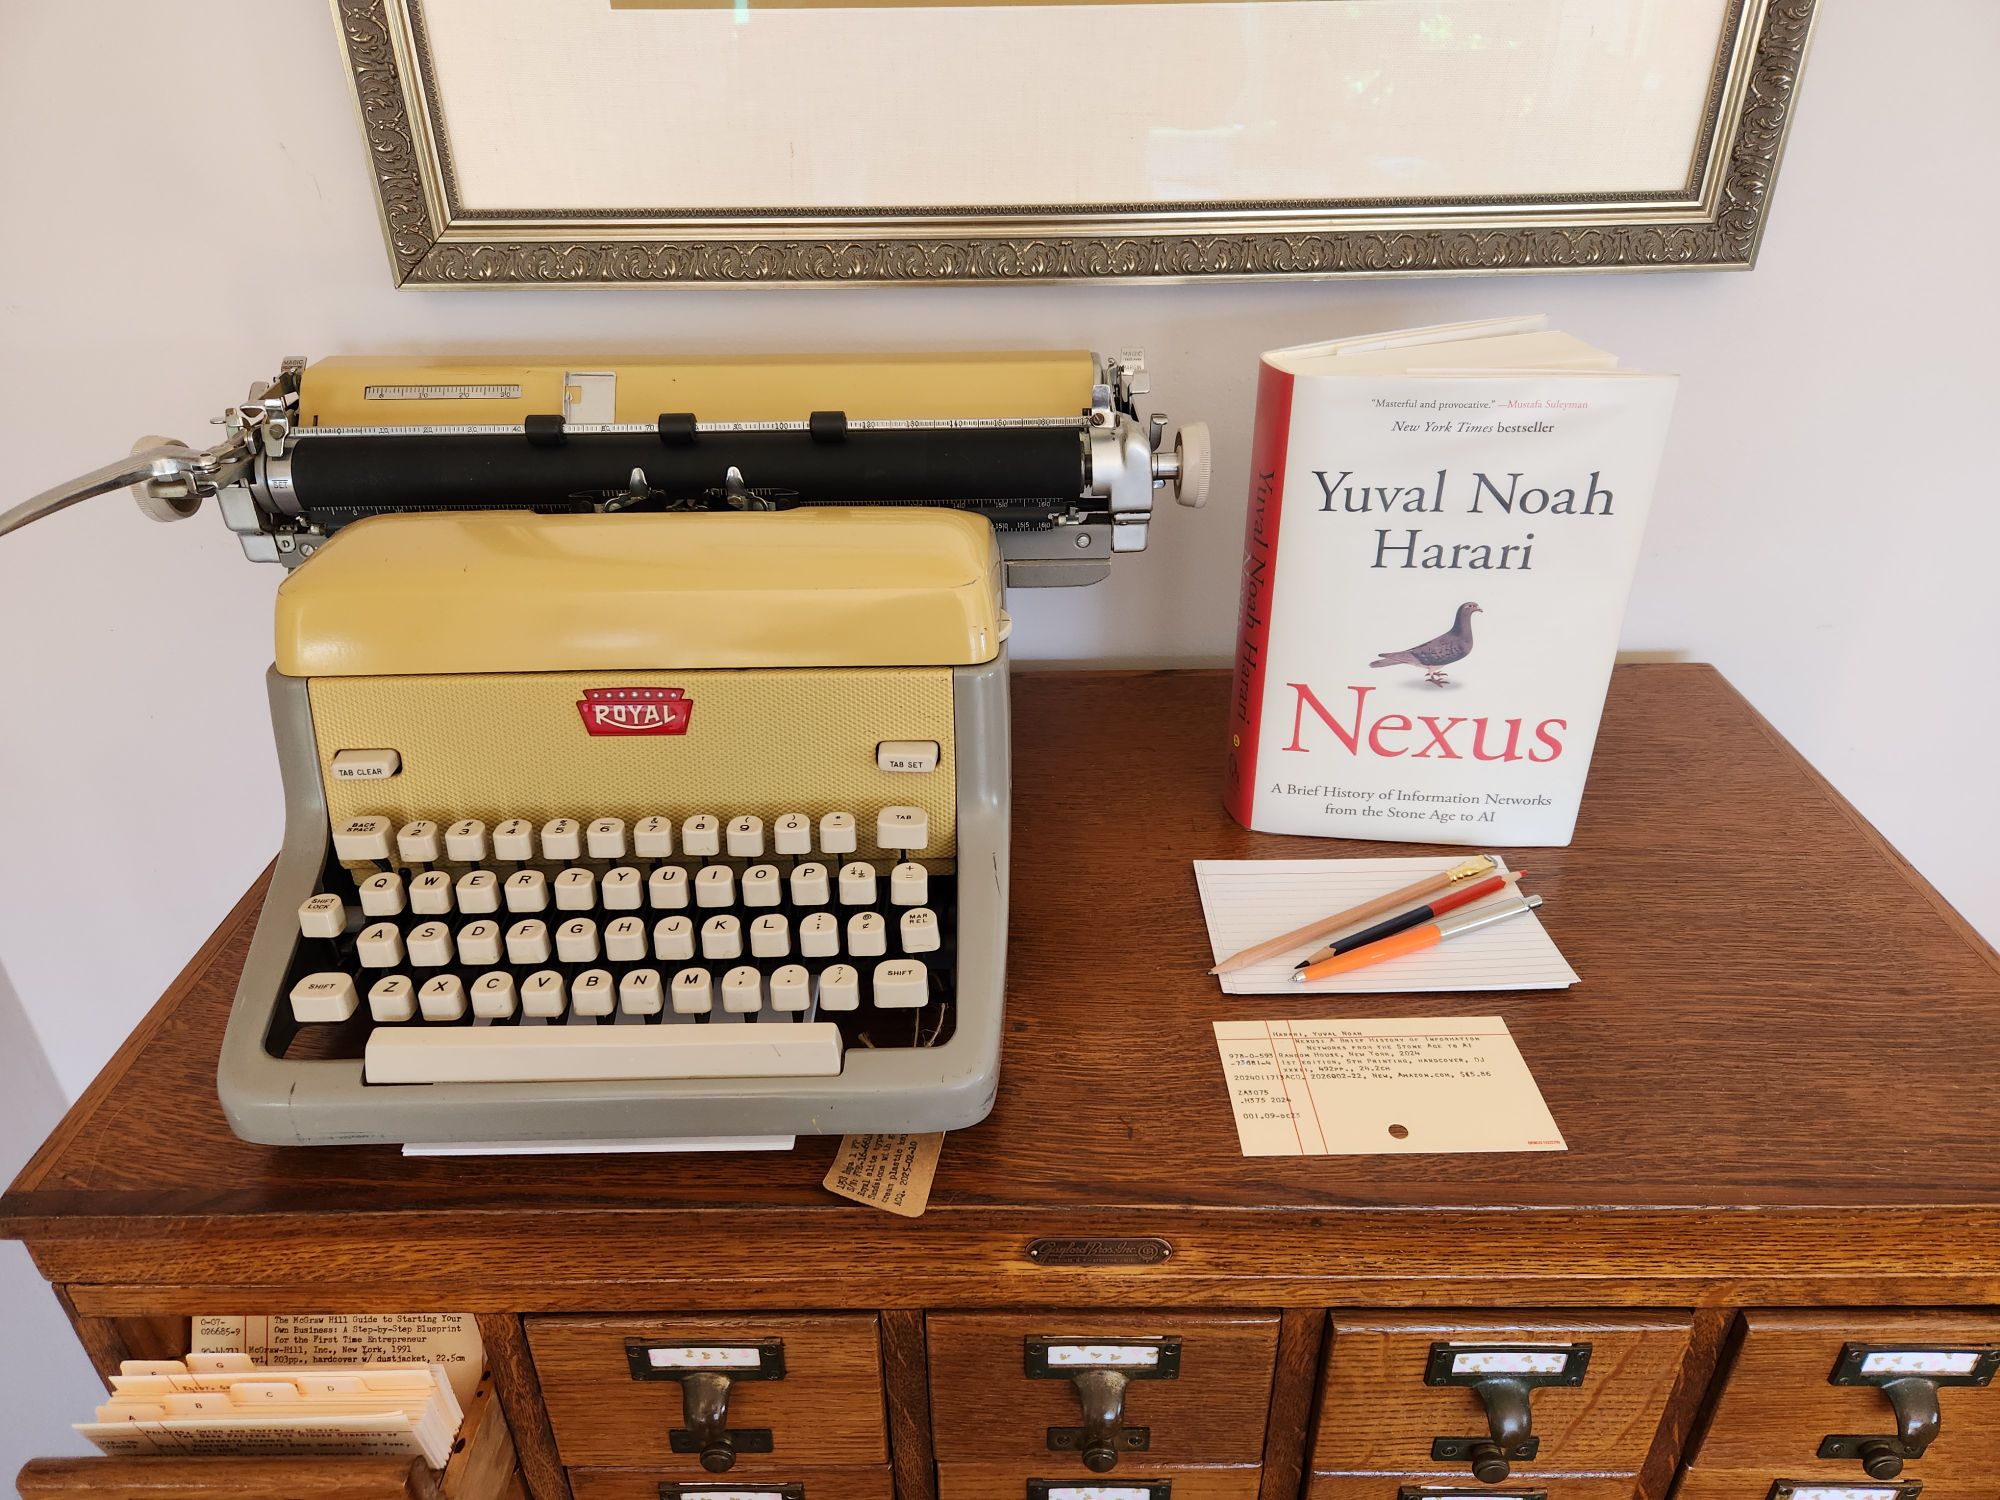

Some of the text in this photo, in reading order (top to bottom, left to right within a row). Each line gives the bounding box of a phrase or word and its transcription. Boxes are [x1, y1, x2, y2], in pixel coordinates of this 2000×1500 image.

[1420, 400, 1436, 409] and
[1545, 400, 1588, 411] Suleyman
[1391, 421, 1554, 433] New York Times bestseller
[1311, 470, 1614, 516] Yuval Noah
[1253, 470, 1275, 548] Yuval
[1370, 528, 1535, 570] Harari
[1245, 552, 1266, 633] Noah
[1237, 639, 1258, 726] Harari
[595, 704, 676, 726] ROYAL
[1282, 683, 1567, 762] Nexus
[356, 768, 383, 776] CLEAR
[1271, 784, 1552, 805] A Brief History of Information Networks
[1325, 803, 1496, 823] from the Stone Age to AI
[375, 879, 387, 888] Q
[424, 876, 440, 886] W
[470, 877, 484, 886] E
[519, 875, 532, 884] R
[571, 874, 582, 882] T
[618, 872, 628, 882] Y
[663, 872, 675, 880] U
[756, 870, 766, 879] O
[371, 920, 774, 939] A S D F G H J K L
[383, 974, 699, 992] Z X C V B N M
[900, 1141, 918, 1186] 2025-02-10
[396, 1315, 437, 1324] Starting
[201, 1328, 240, 1336] 026685-9
[352, 1325, 412, 1334] Step-by-Step
[416, 1325, 462, 1333] Blueprint
[368, 1335, 427, 1344] Entrepreneur
[249, 1346, 307, 1354] McGraw-Hill,
[314, 1346, 336, 1354] Inc.,
[362, 1345, 386, 1354] York,
[313, 1355, 358, 1363] hardcover
[362, 1354, 372, 1362] w/
[377, 1355, 430, 1363] dustjacket,
